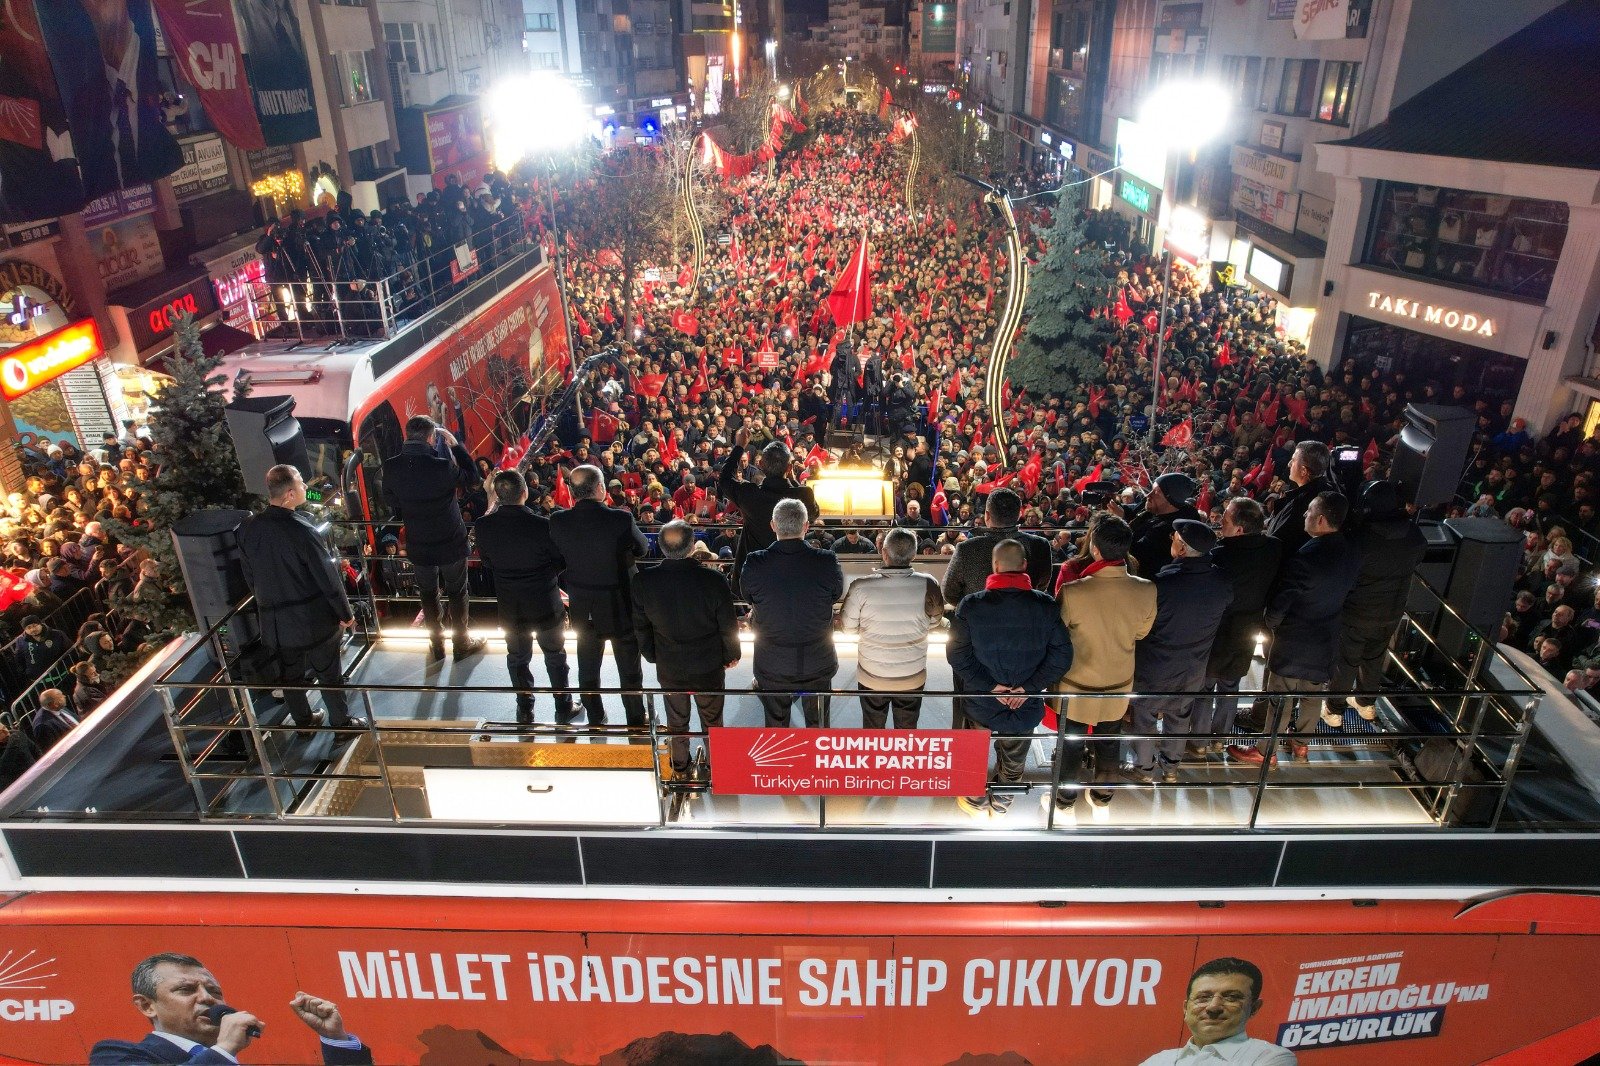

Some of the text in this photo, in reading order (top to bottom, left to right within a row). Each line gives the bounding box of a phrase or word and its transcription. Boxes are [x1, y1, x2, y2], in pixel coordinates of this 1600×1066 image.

[1369, 292, 1494, 337] TAKI MODA
[815, 733, 954, 752] CUMHURİYET
[815, 751, 953, 770] HALK PARTİSİ
[751, 773, 951, 791] Türkiye'nin Birinci Partisi
[338, 950, 511, 1001] MİLLET
[799, 956, 948, 1007] SAHİP
[962, 958, 1163, 1015] ÇIKIYOR
[1294, 962, 1401, 997] EKREM
[1, 999, 75, 1021] CHP
[1287, 981, 1490, 1022] İMAMOĞLU'NA
[1281, 1010, 1438, 1048] ÖZGÜRLÜK
